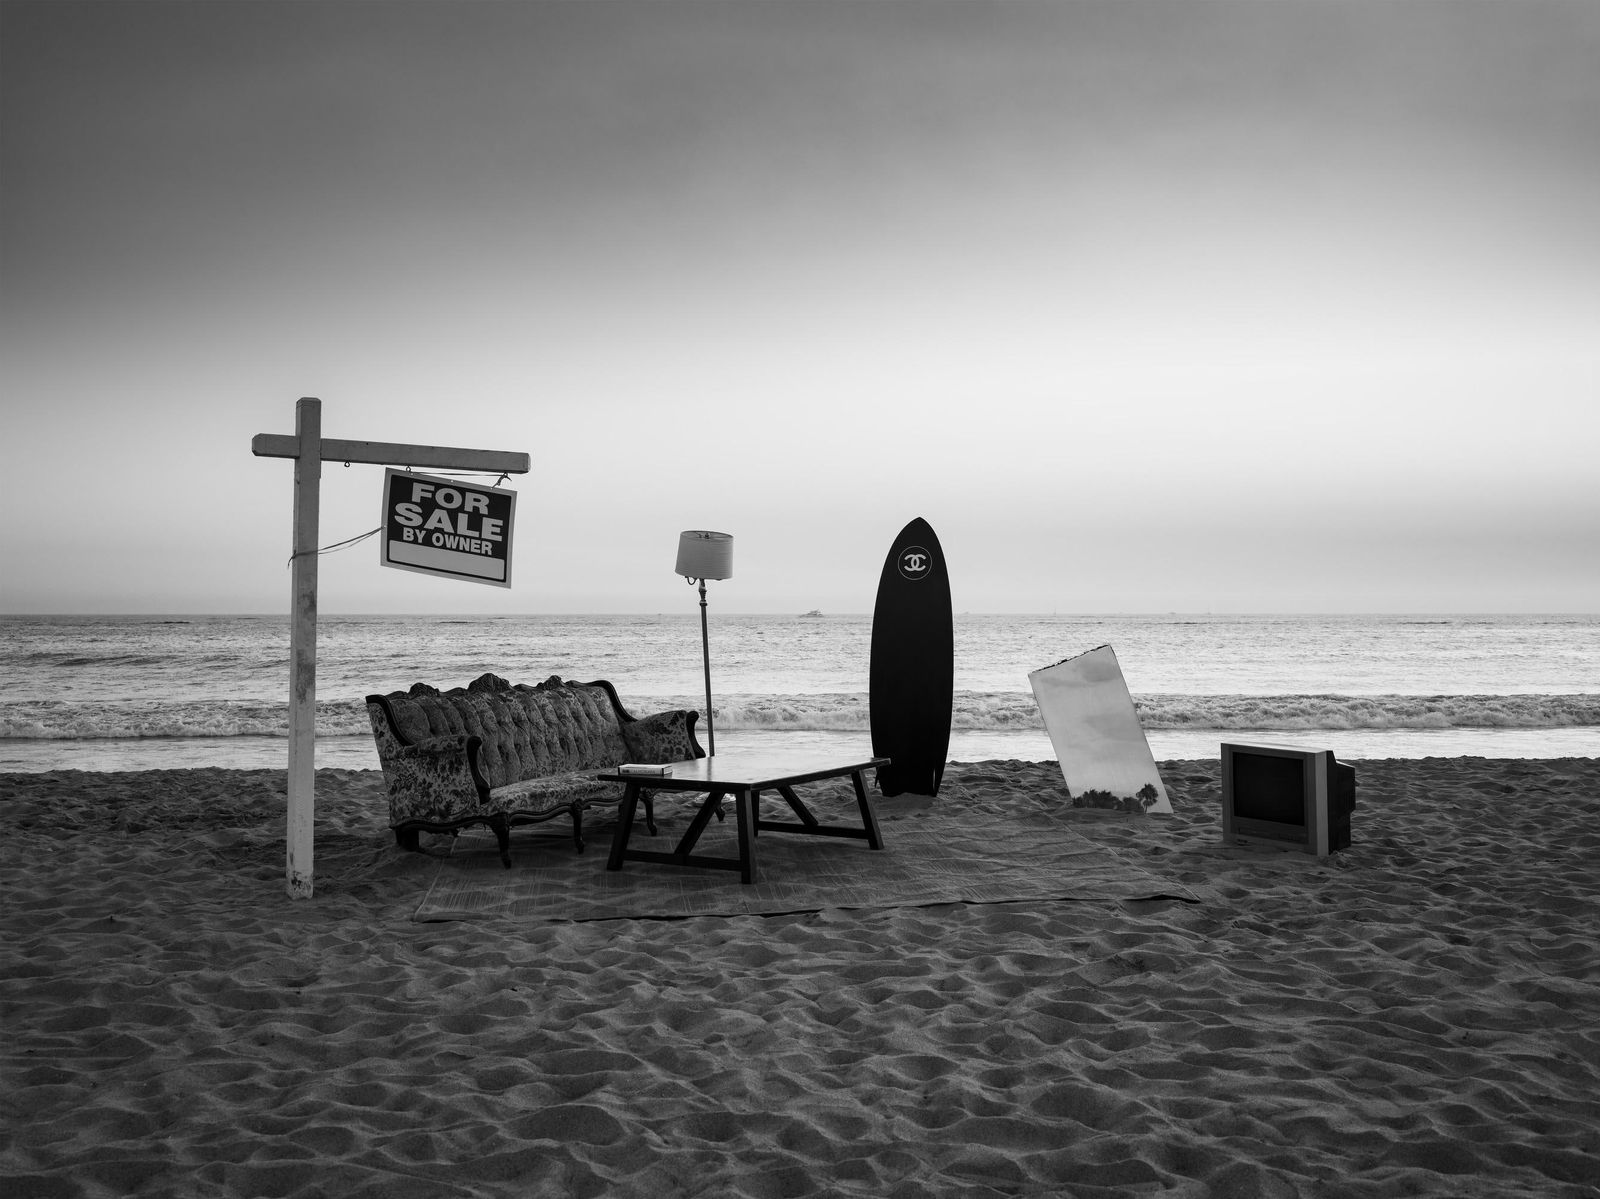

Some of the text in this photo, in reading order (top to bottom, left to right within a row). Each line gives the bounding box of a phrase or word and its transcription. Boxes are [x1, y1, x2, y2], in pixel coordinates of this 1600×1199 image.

[412, 482, 489, 515] FOR
[394, 502, 503, 541] SALE
[402, 527, 493, 555] BY OWNER
